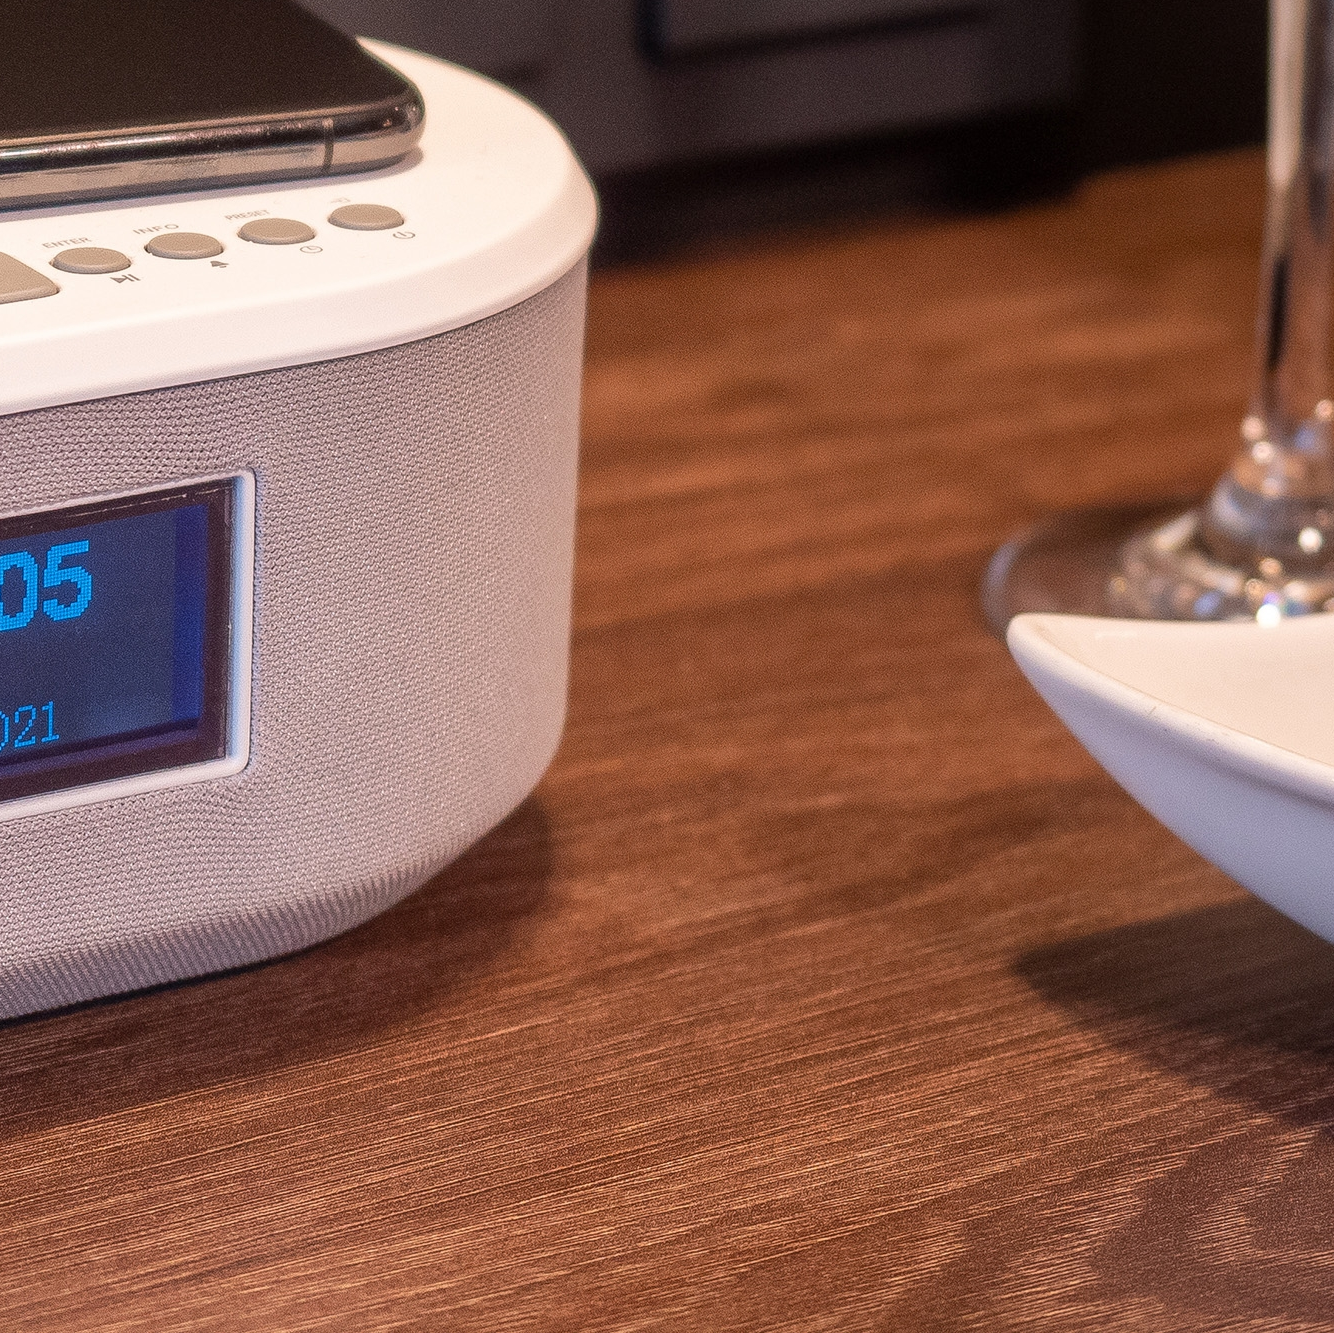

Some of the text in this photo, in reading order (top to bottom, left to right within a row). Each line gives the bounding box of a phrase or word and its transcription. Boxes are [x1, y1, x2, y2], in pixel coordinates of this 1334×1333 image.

[224, 209, 271, 222] PRESET
[132, 223, 180, 235] INFO
[42, 236, 91, 249] ENTER
